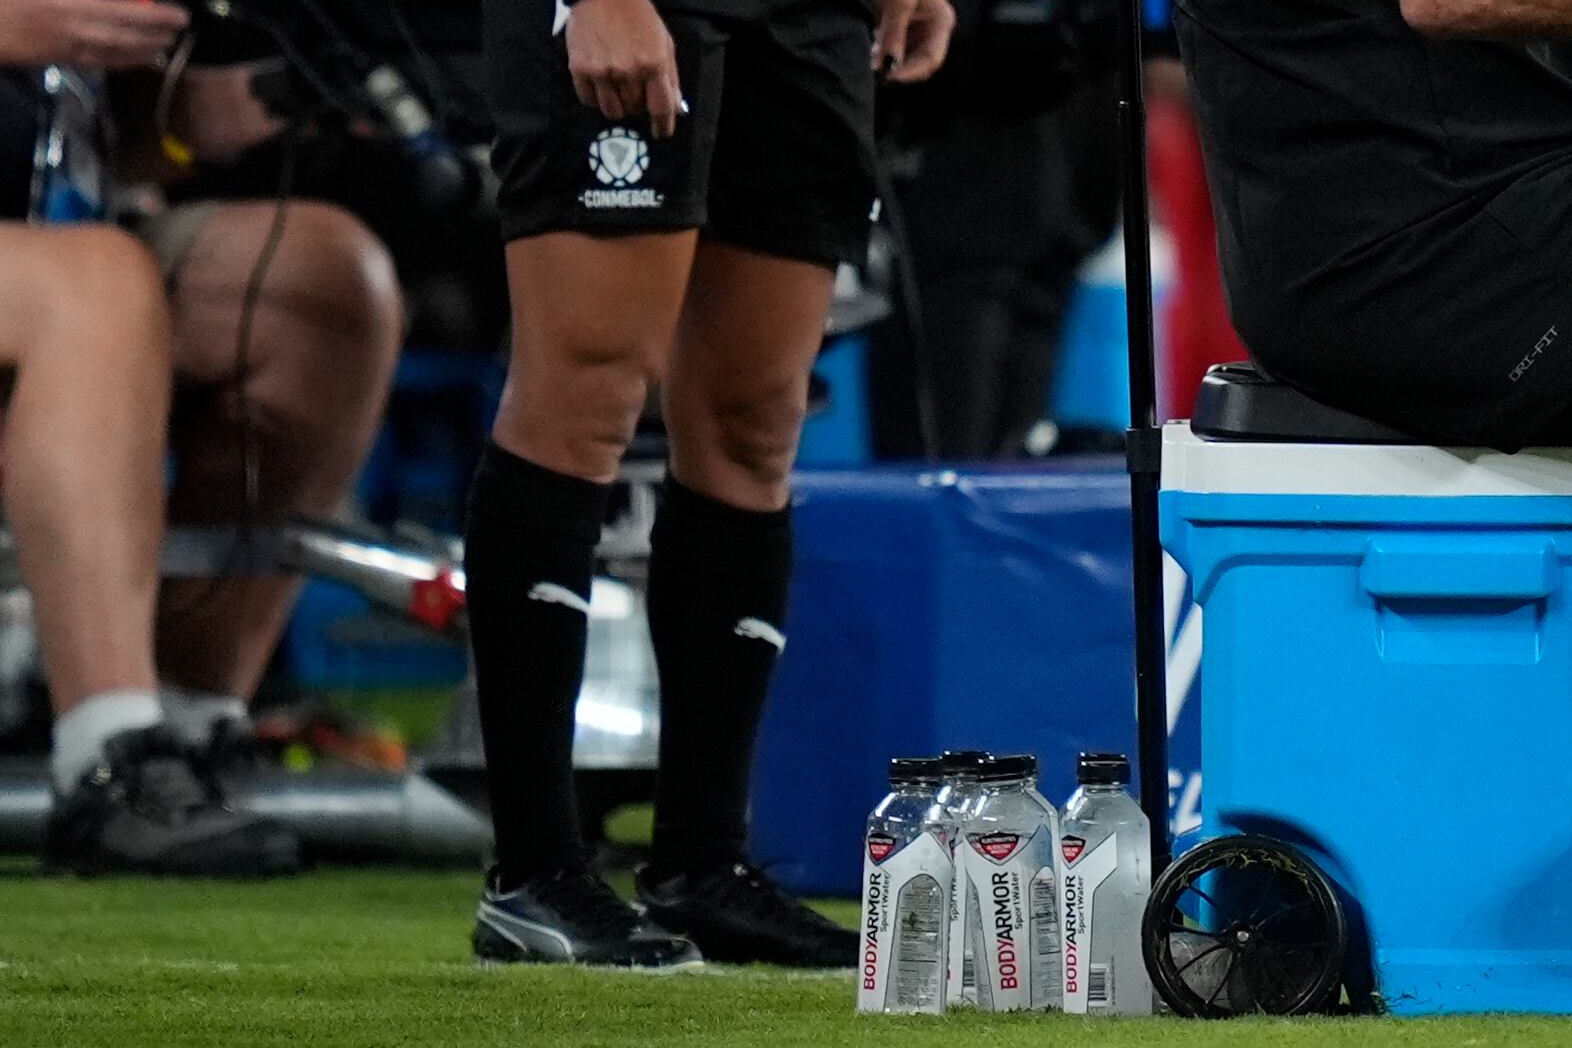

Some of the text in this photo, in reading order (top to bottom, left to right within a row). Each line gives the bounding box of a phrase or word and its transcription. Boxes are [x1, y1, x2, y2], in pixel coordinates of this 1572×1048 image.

[1508, 324, 1558, 382] DRI-FIT
[863, 872, 881, 990] BODYARMOR
[992, 871, 1018, 990] BODYARMOR
[1065, 875, 1078, 993] BODYARMOR
